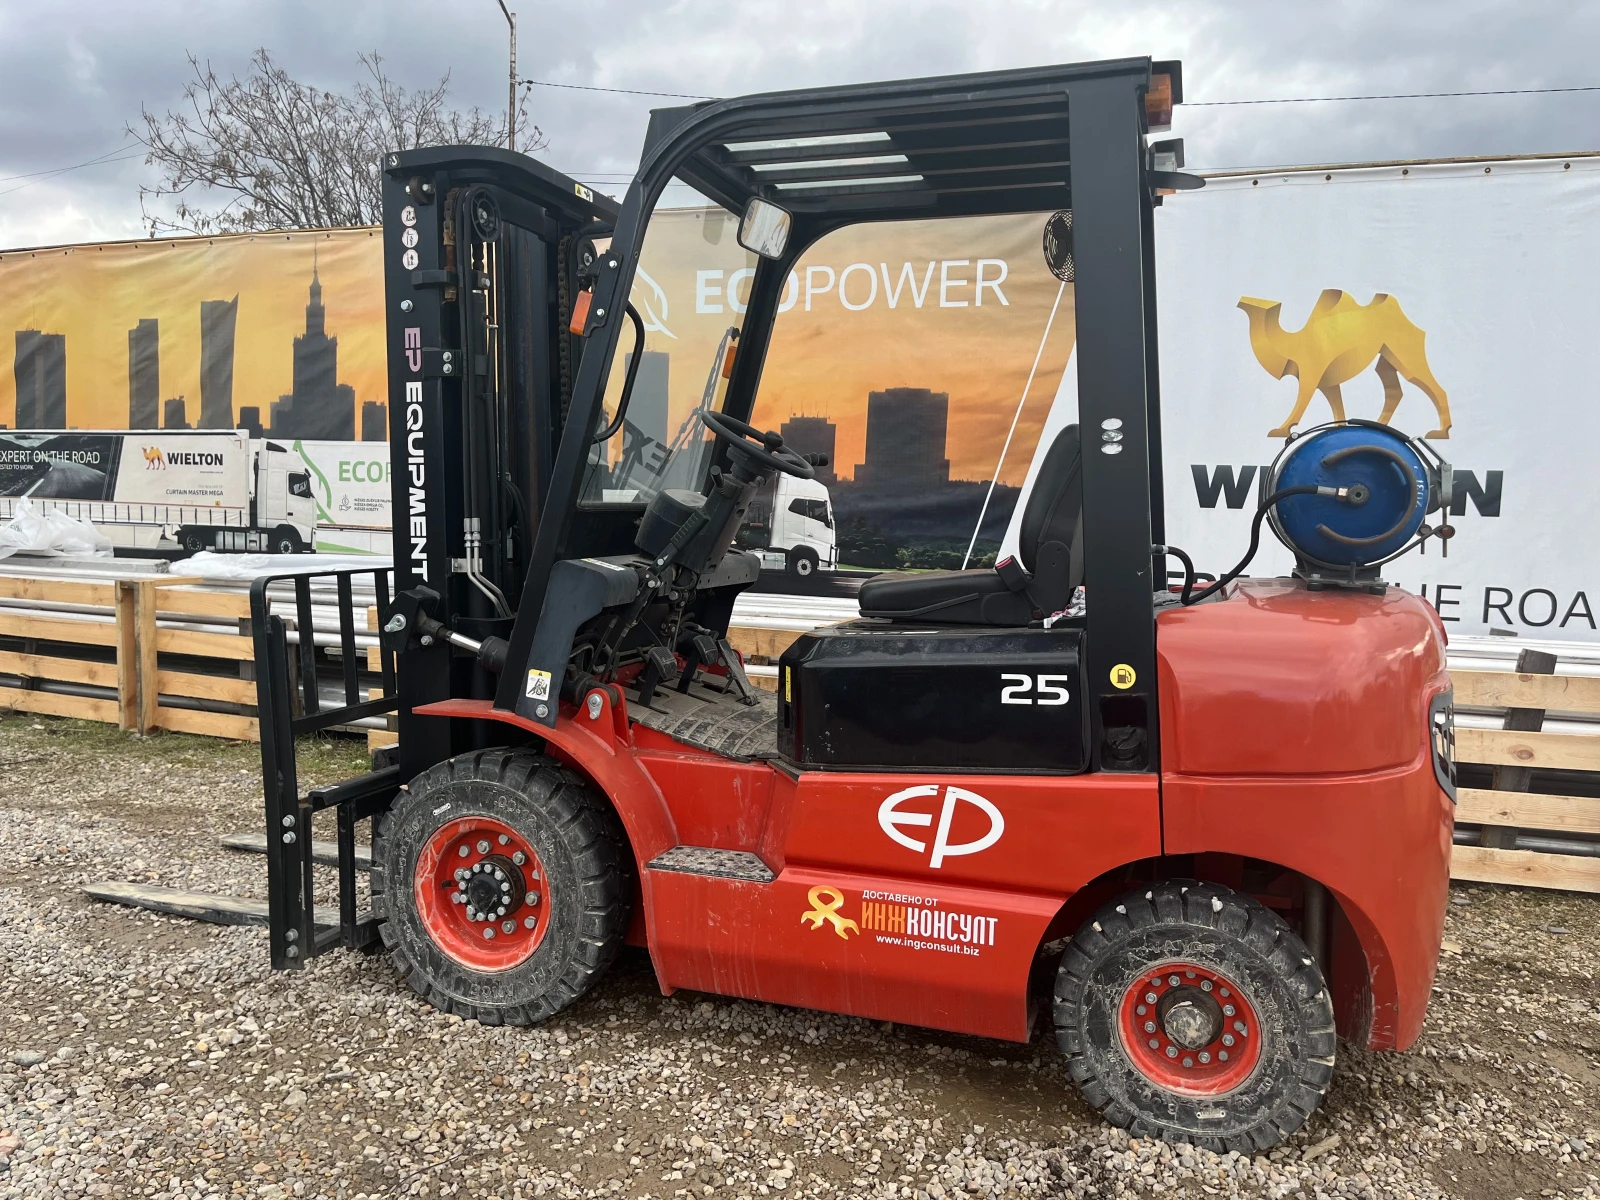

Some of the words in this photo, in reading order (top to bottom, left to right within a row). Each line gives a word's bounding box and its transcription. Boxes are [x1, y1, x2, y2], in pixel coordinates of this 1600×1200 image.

[404, 327, 422, 373] EP
[0, 450, 31, 463] XPERT
[33, 450, 48, 463] ON
[51, 451, 70, 463] THE
[72, 451, 100, 464] ROAD
[167, 452, 223, 466] WIELTON
[405, 381, 429, 583] EQUIPMENT
[1001, 673, 1070, 706] 25
[877, 784, 1005, 869] EP
[862, 889, 922, 905] ДОСТАВЕНО
[924, 897, 939, 907] ОТ
[861, 901, 999, 946] ИНЖКОНСУЛТ
[876, 935, 980, 956] www.ingconsult.biz
